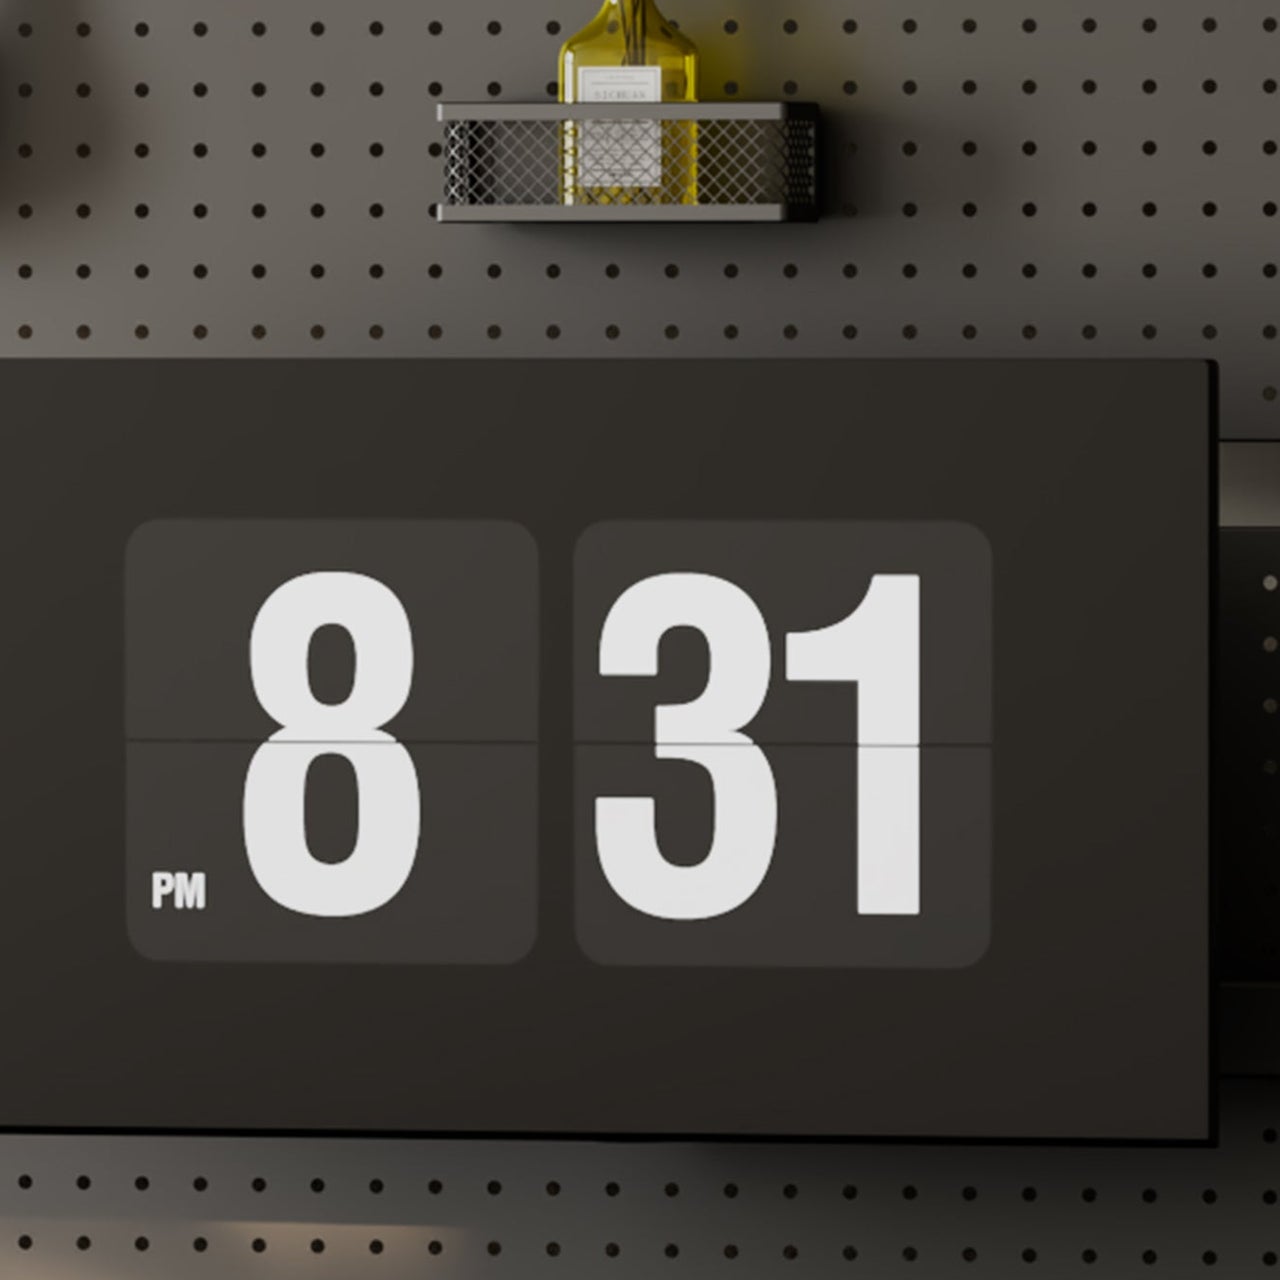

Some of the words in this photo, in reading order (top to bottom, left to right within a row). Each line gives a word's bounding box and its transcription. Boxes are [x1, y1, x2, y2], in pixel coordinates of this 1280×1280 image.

[243, 571, 421, 917] 8
[595, 572, 920, 920] 31
[152, 871, 206, 910] PM
